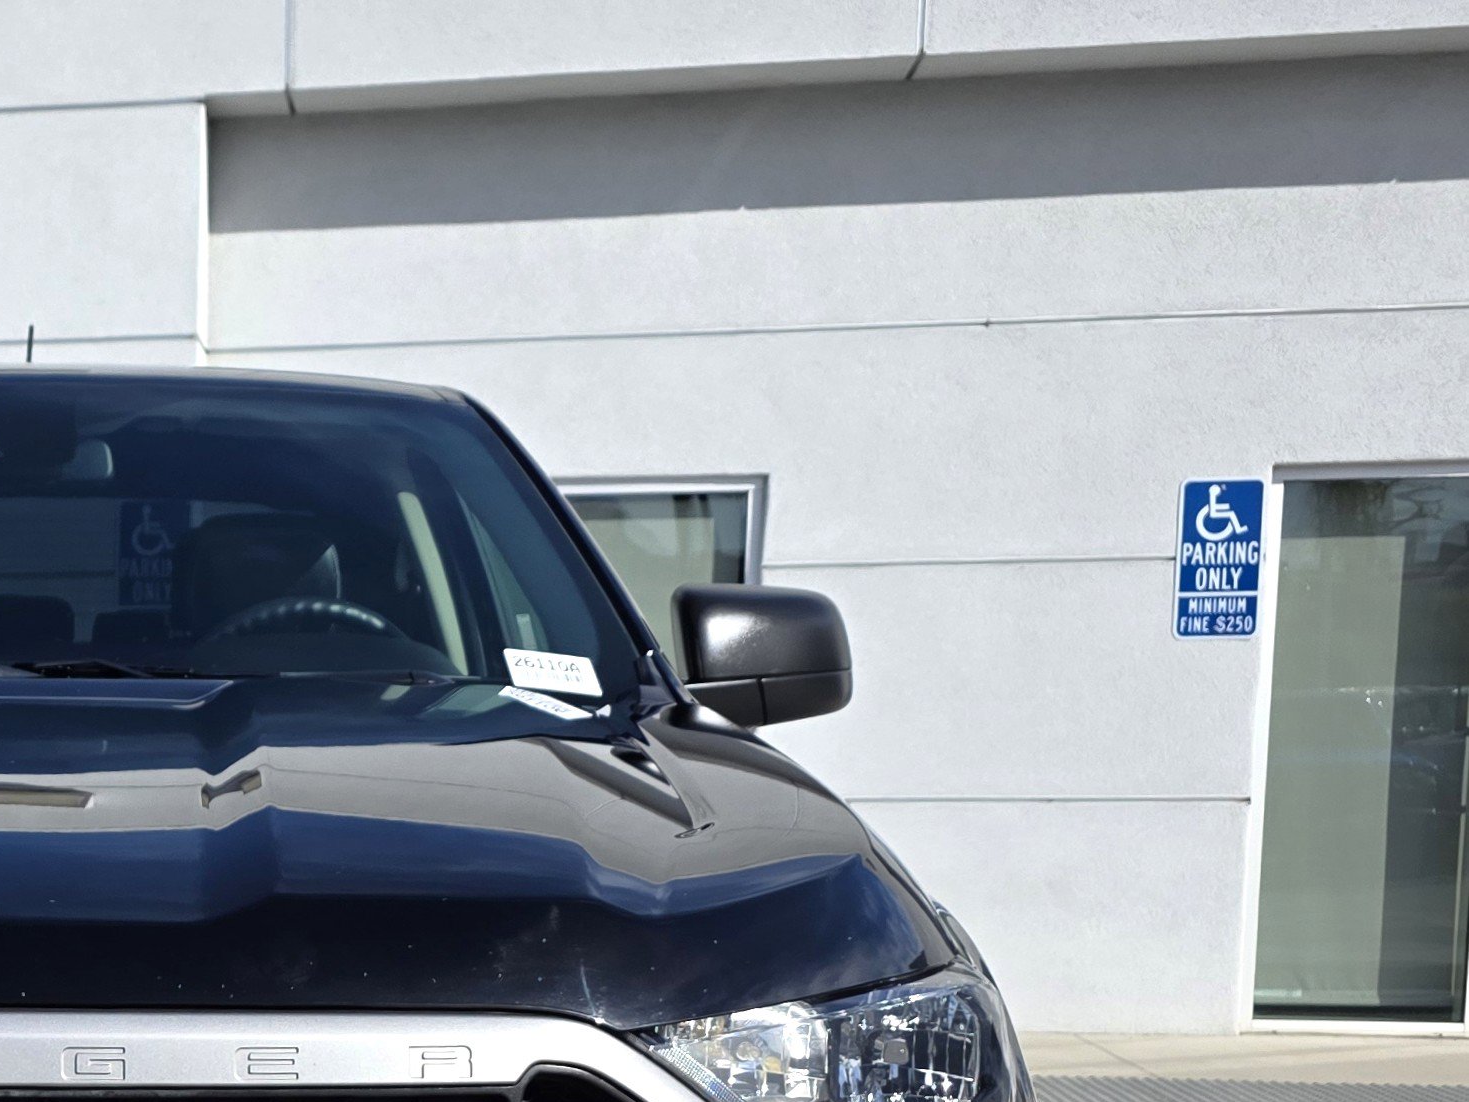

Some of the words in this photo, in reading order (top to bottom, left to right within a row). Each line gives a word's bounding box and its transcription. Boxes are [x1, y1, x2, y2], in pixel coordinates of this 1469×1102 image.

[1182, 541, 1259, 566] PARKING
[1195, 567, 1243, 590] ONLY
[1188, 597, 1246, 614] MINIMUM
[1180, 617, 1209, 633] FINE
[1213, 616, 1253, 632] $250
